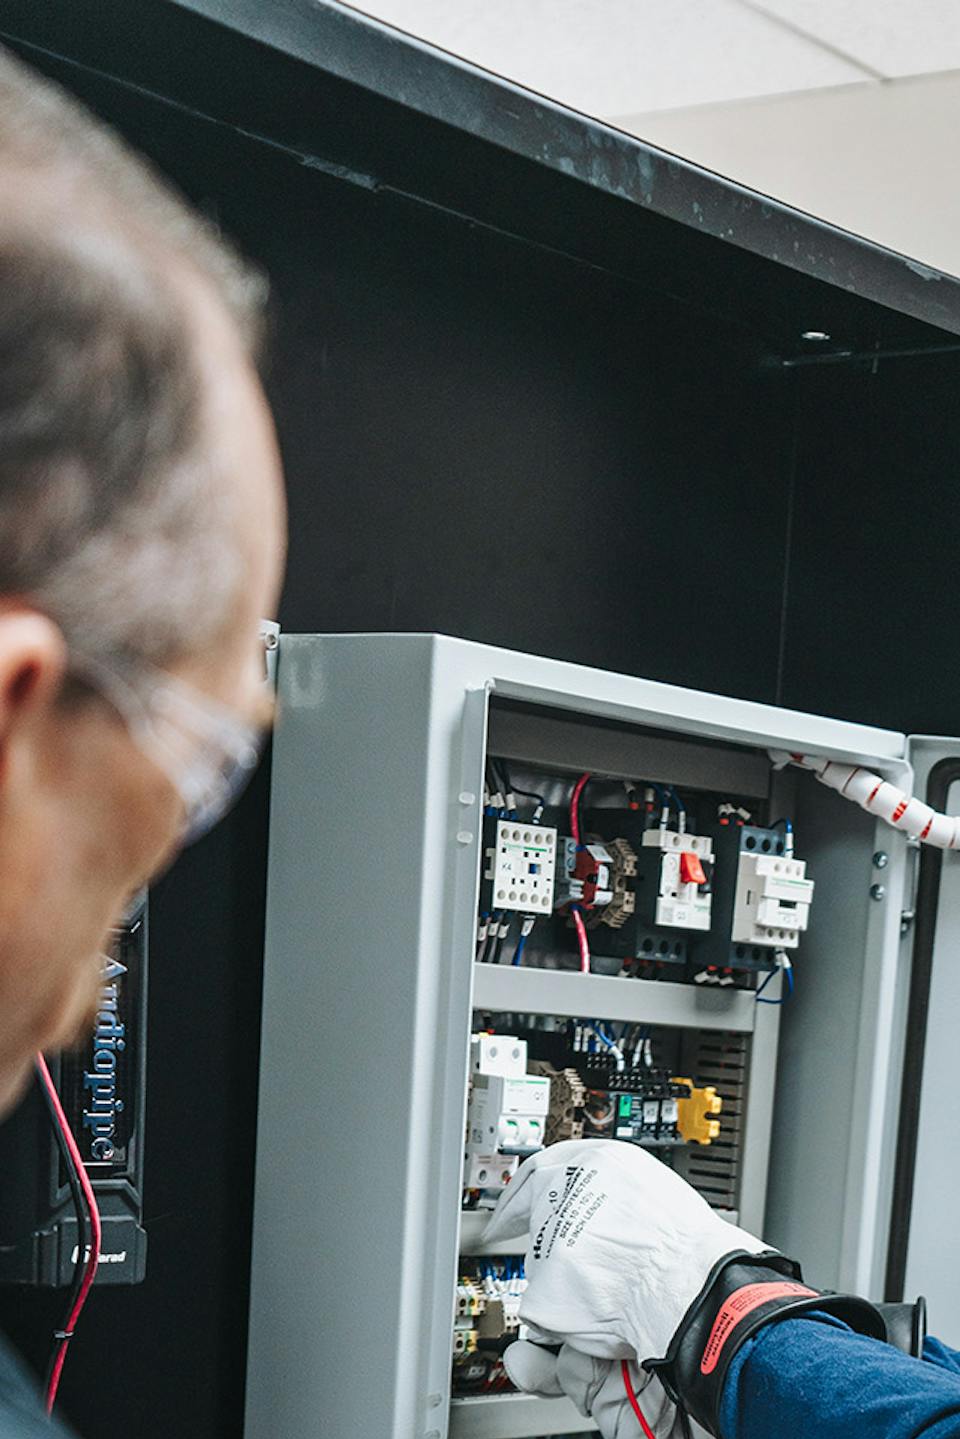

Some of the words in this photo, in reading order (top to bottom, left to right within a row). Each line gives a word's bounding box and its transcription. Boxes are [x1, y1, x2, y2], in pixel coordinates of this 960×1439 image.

[83, 952, 129, 1160] Audiopipe
[548, 1190, 558, 1203] 10
[559, 1169, 598, 1218] PROTECTORS
[571, 1220, 587, 1239] INCH
[583, 1192, 608, 1221] LENGTH
[559, 1219, 573, 1239] SIZE
